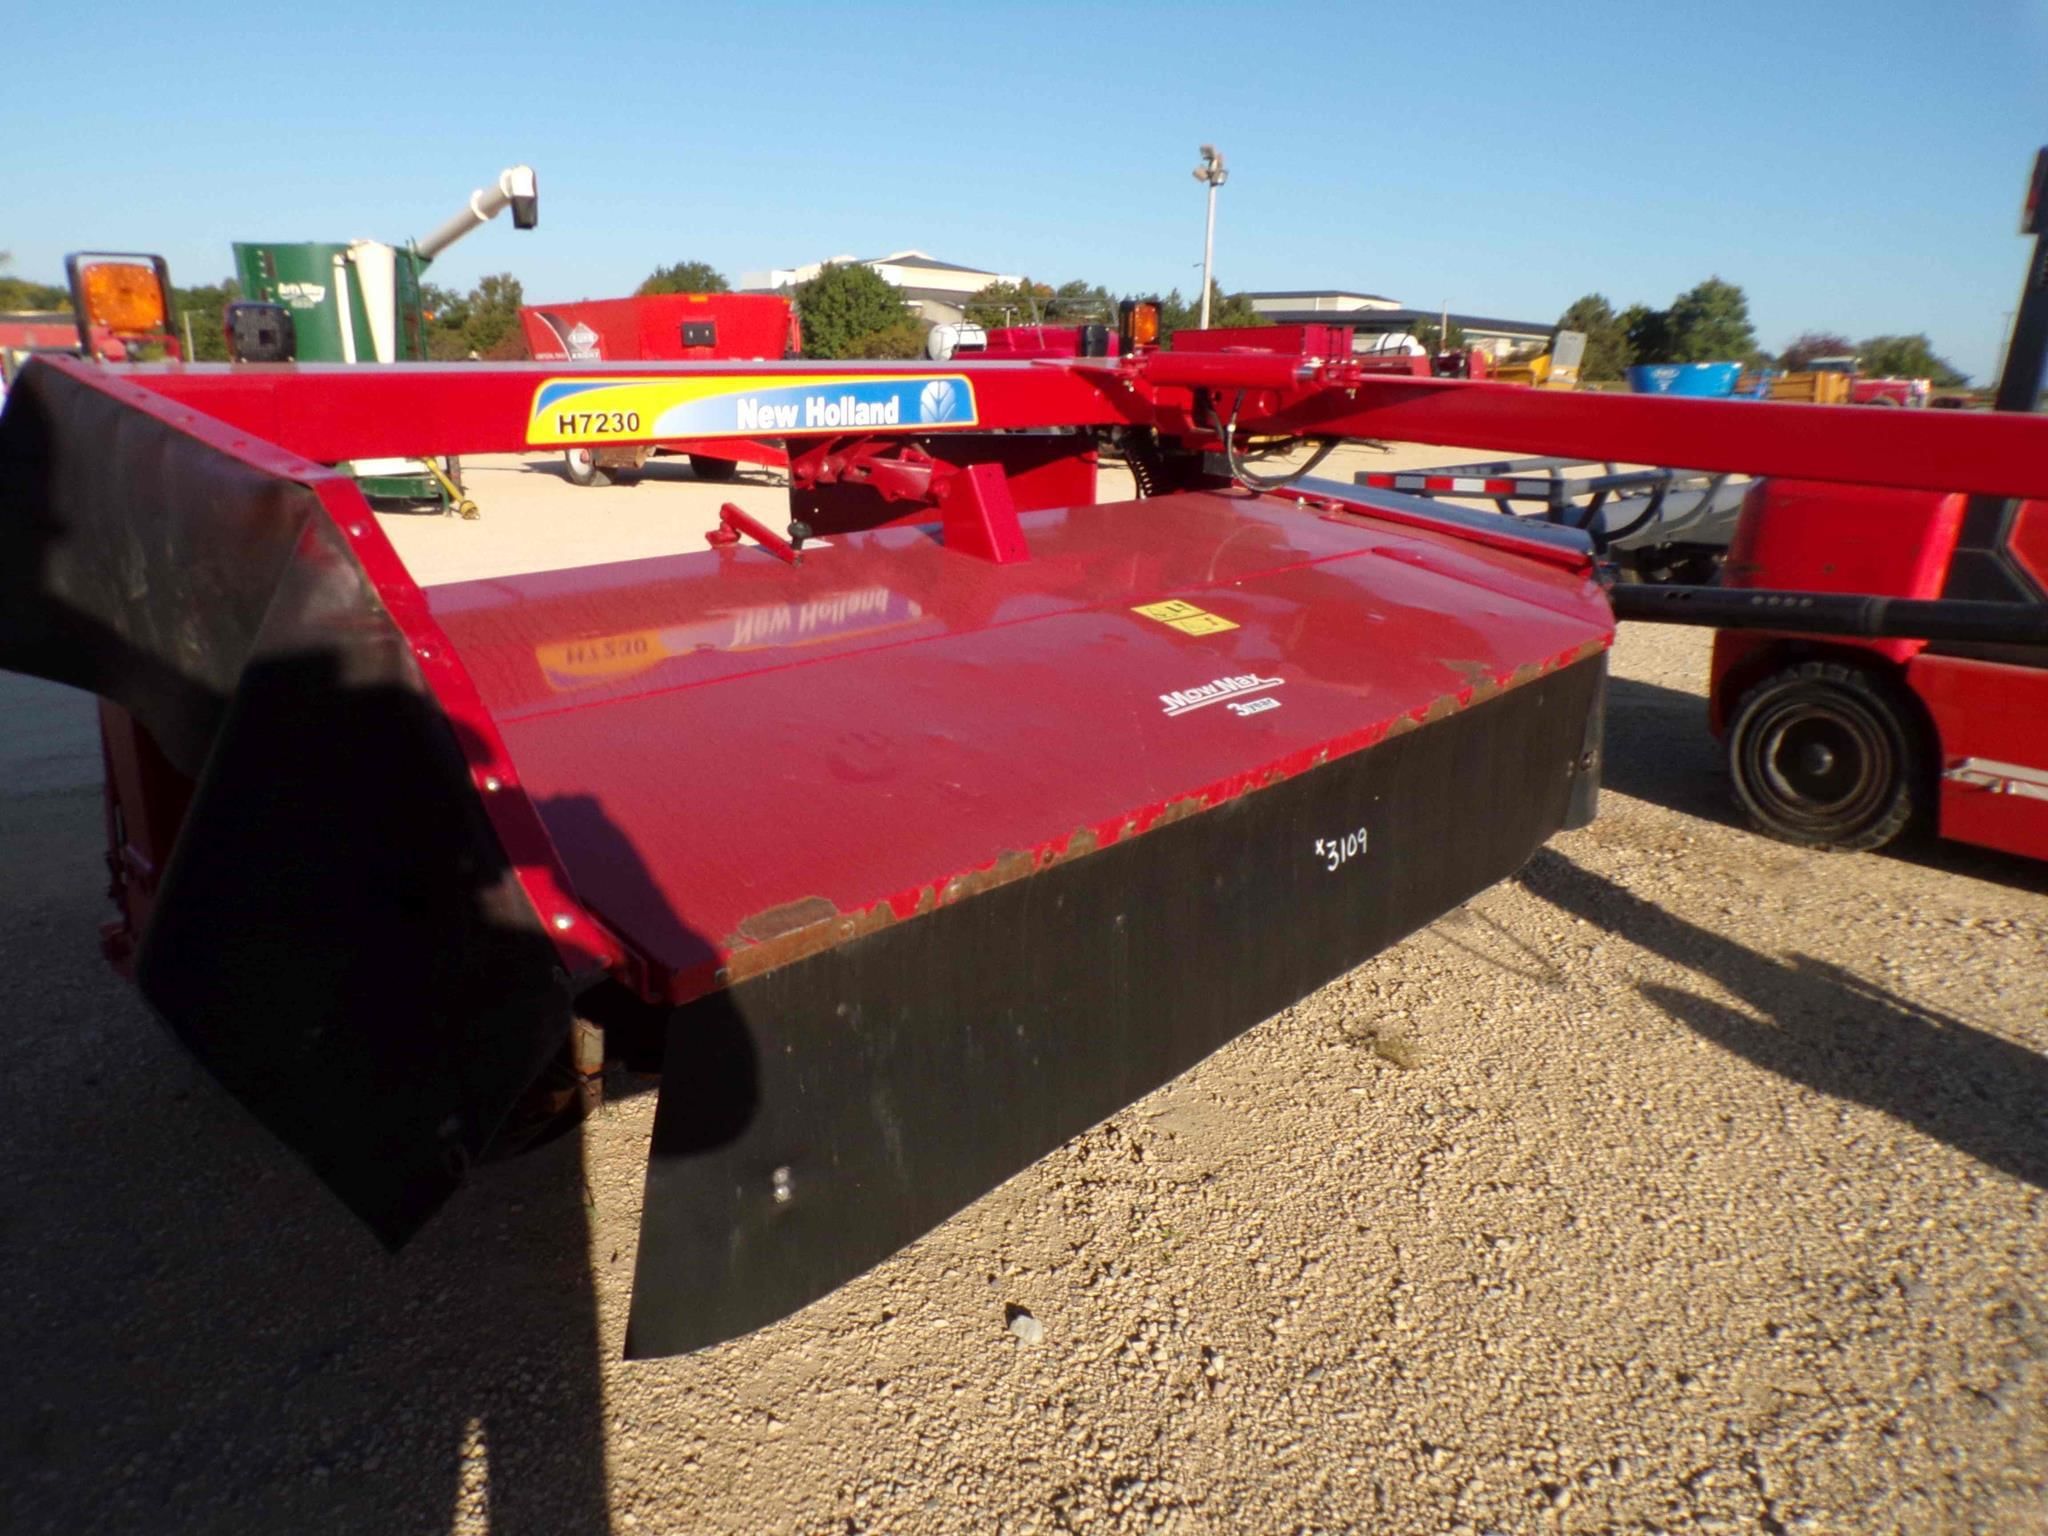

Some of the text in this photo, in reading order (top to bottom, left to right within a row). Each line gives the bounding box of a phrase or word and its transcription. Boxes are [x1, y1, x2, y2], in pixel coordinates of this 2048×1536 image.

[558, 412, 641, 434] H7230
[736, 395, 899, 430] New Holland
